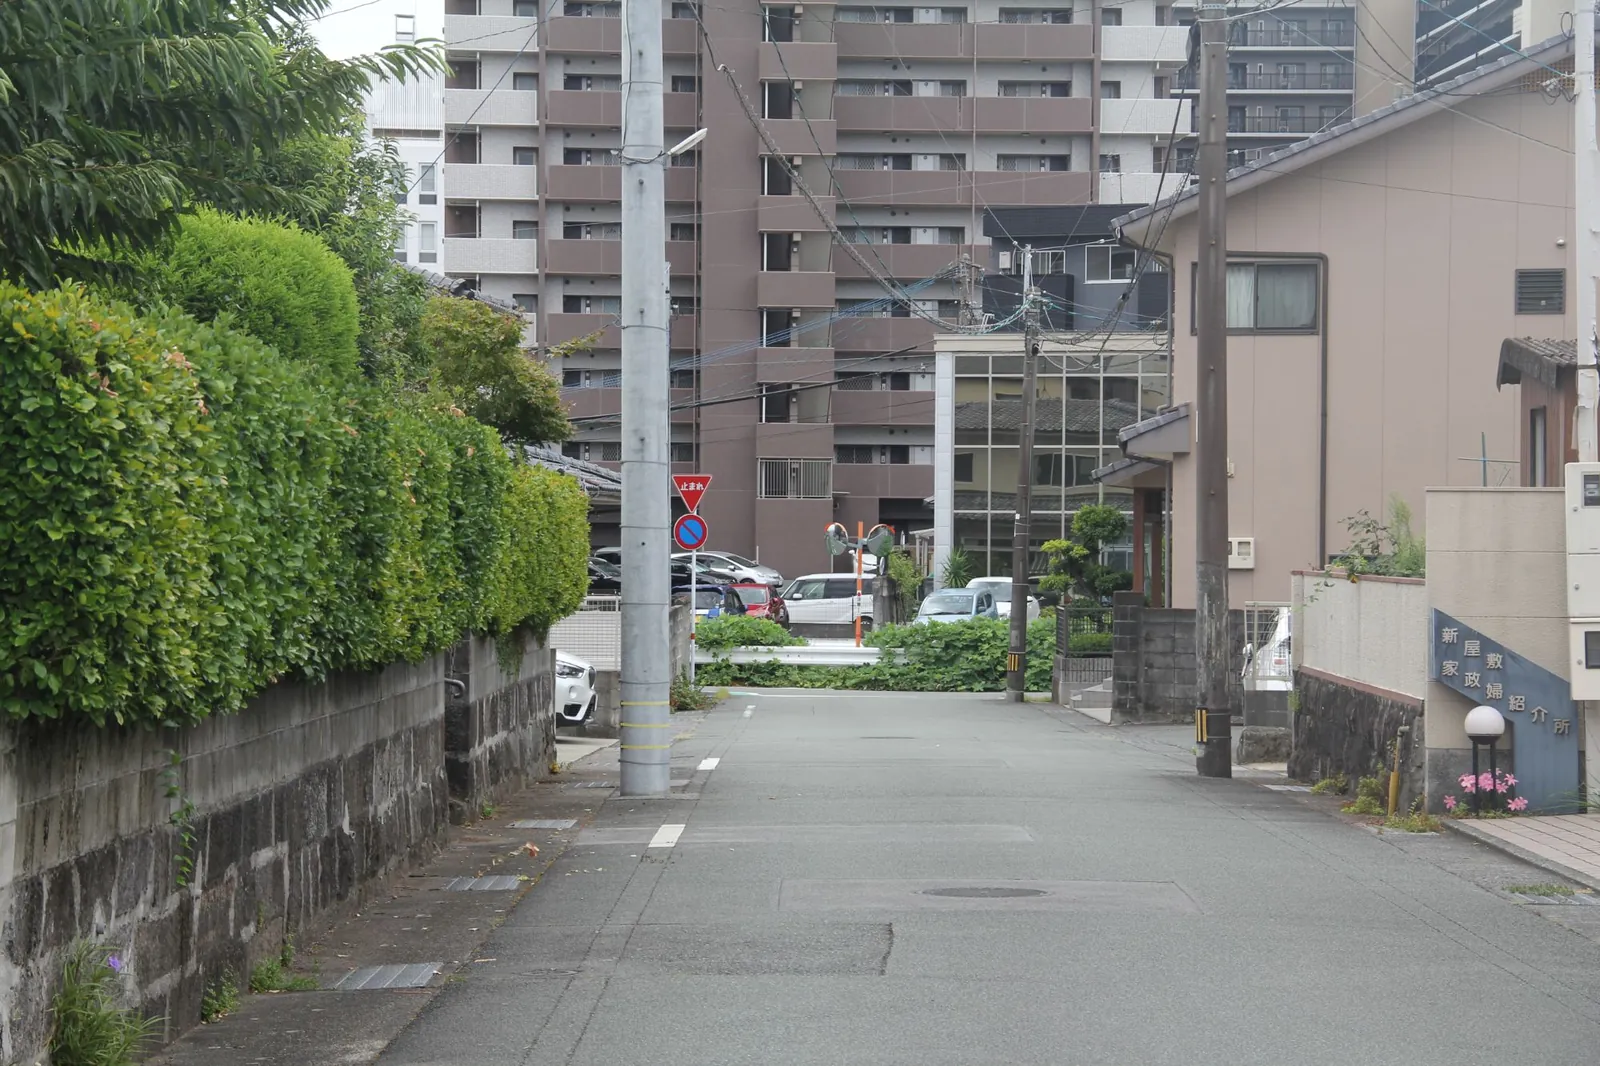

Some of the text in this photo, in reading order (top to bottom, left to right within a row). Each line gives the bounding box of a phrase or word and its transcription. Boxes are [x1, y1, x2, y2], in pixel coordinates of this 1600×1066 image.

[680, 481, 705, 491] 止まれ
[1441, 626, 1503, 669] 新屋敷
[1441, 660, 1570, 734] 家政婦紹介所
